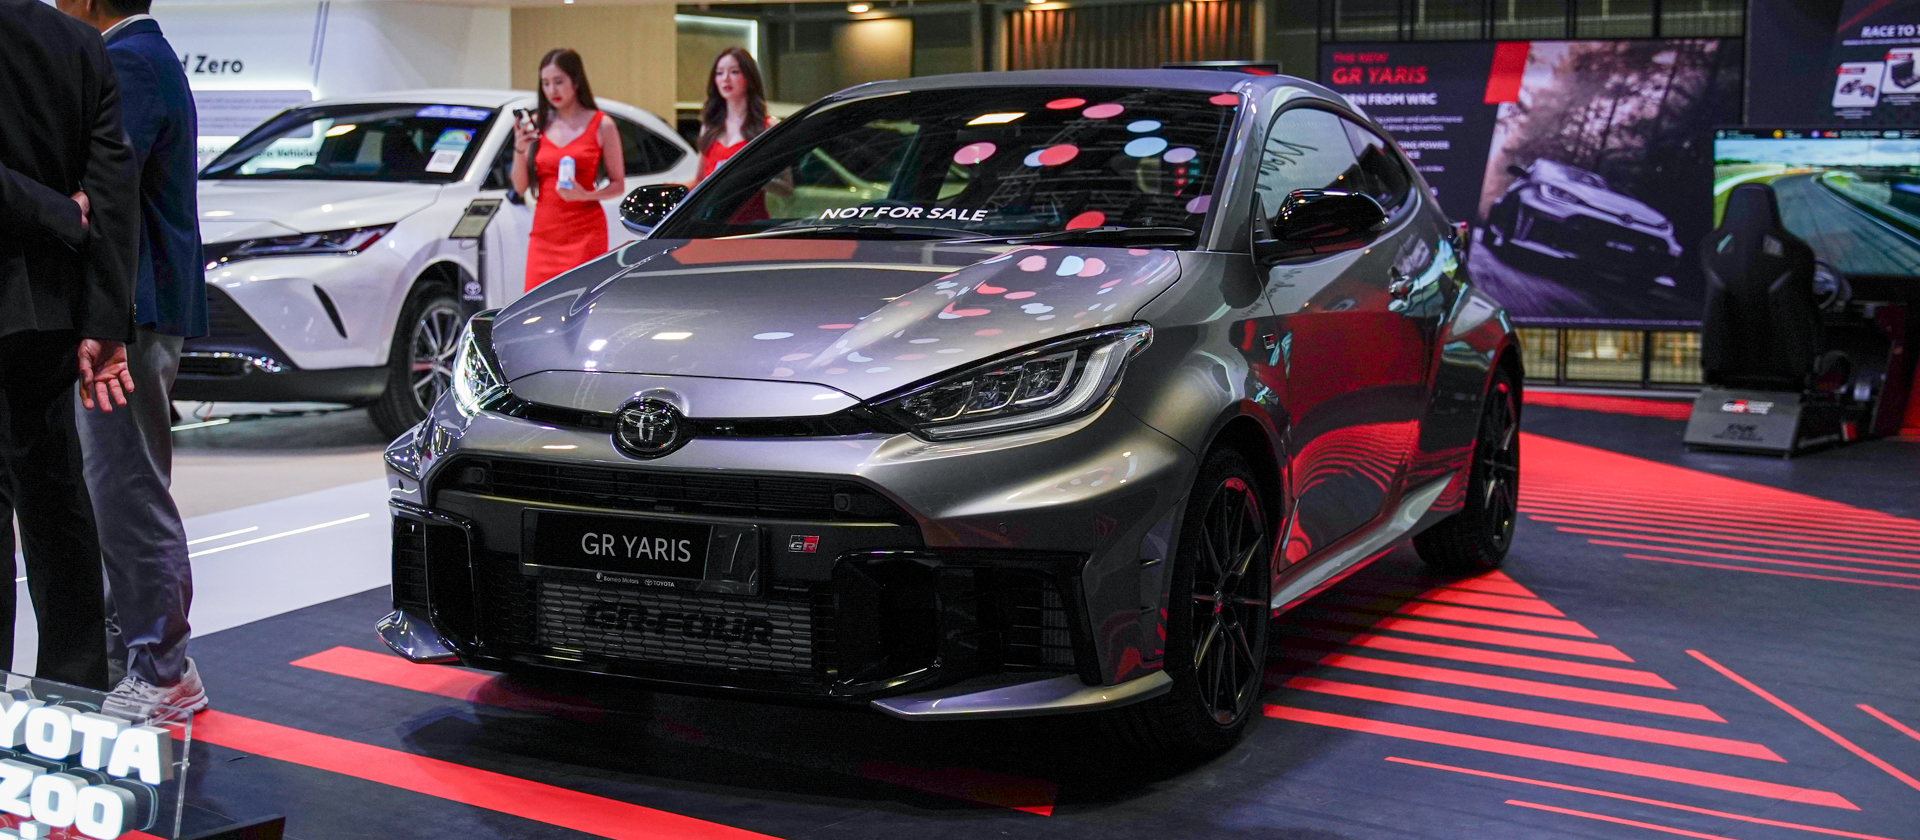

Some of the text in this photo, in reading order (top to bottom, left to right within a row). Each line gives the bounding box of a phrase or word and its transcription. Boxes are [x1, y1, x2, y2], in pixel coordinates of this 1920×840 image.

[1861, 25, 1896, 38] RACE
[1897, 24, 1915, 37] TO
[194, 55, 244, 73] Zero
[1332, 65, 1428, 85] GR YARIS
[1368, 92, 1405, 106] FROM
[1406, 92, 1438, 106] WRC
[819, 206, 988, 222] NOT FOR SALE
[581, 532, 691, 563] GR YARIS
[789, 539, 818, 552] GR
[583, 601, 774, 645] GR-FOUR
